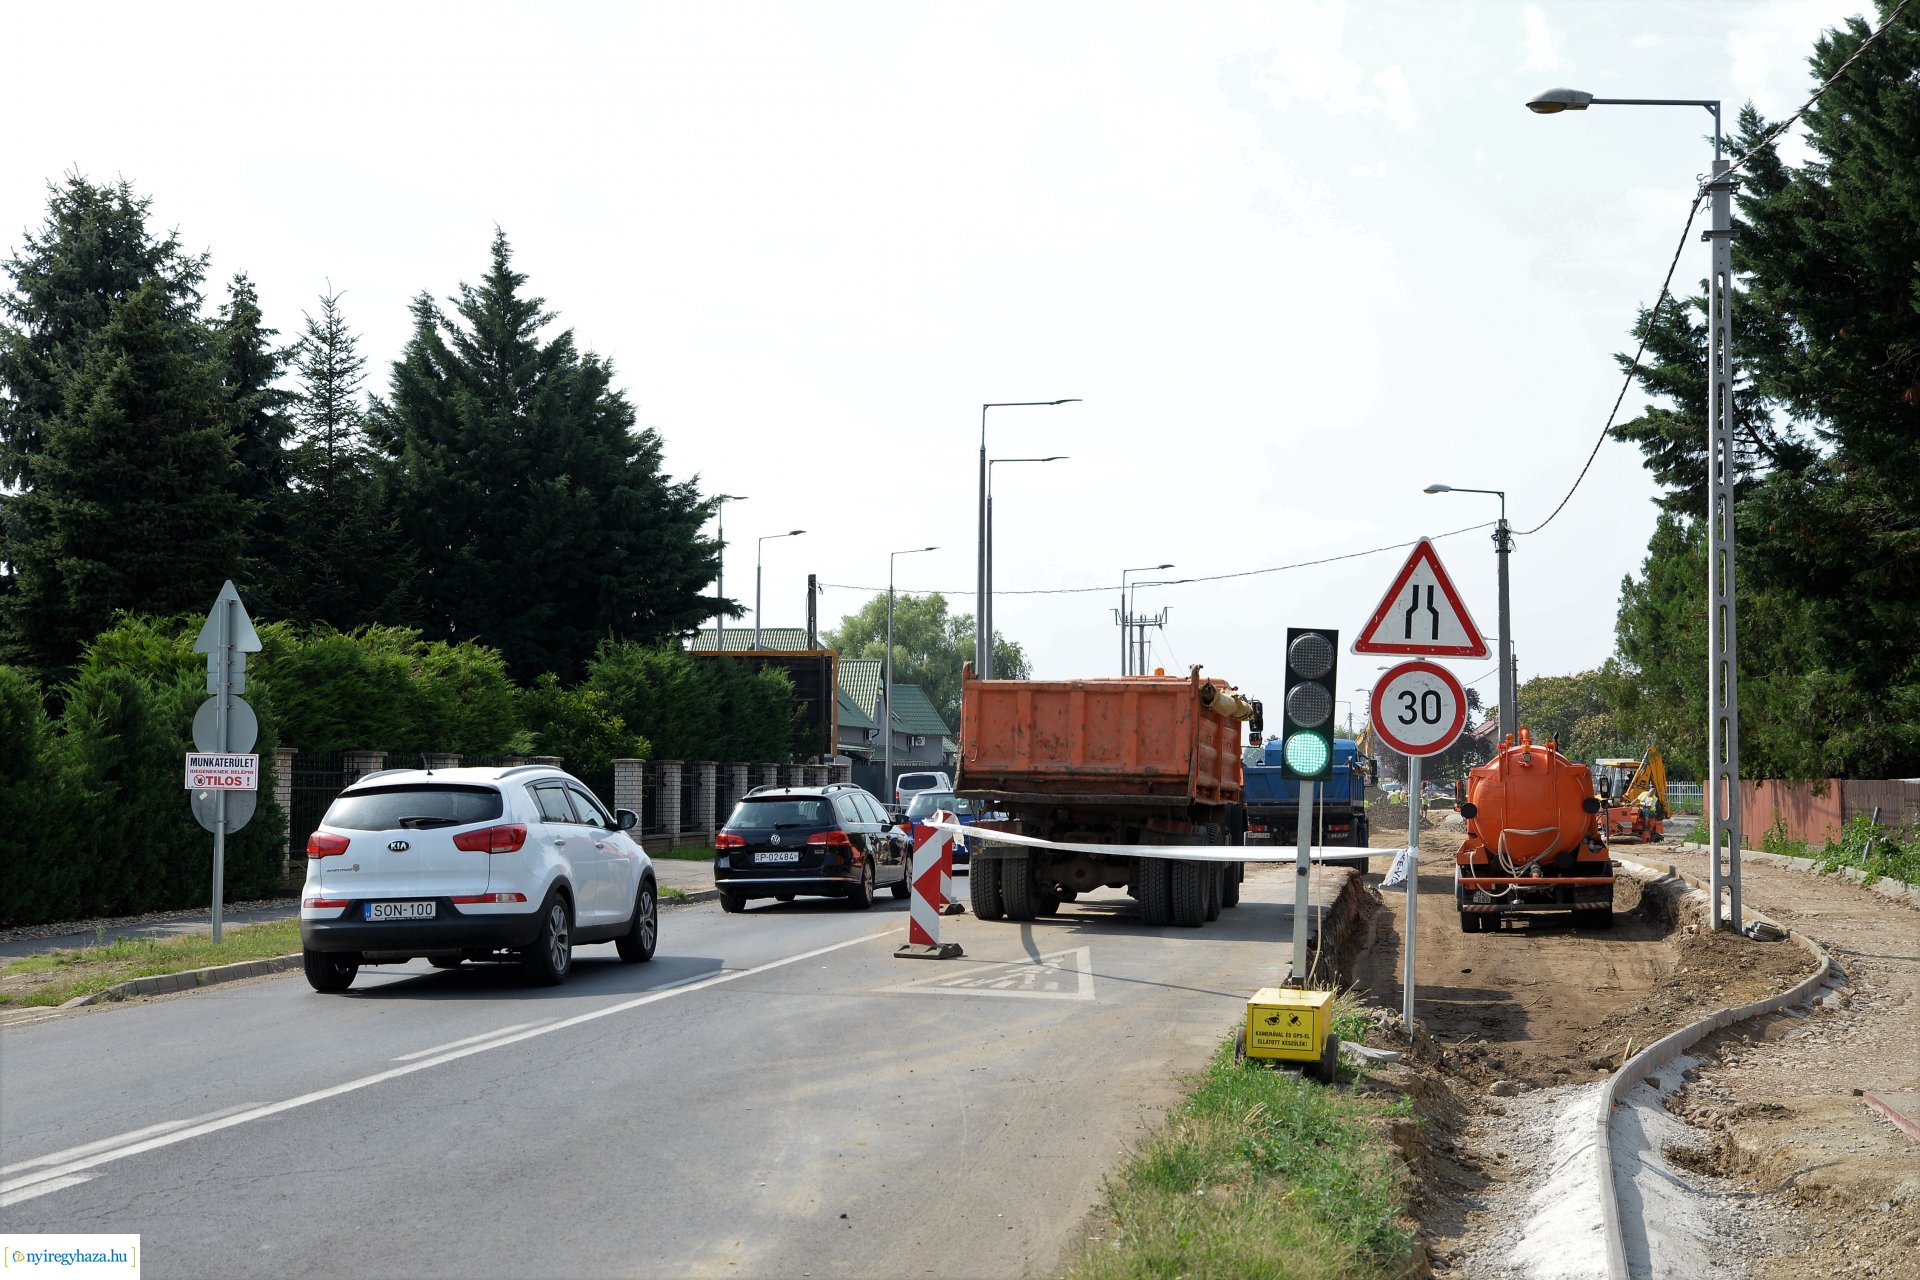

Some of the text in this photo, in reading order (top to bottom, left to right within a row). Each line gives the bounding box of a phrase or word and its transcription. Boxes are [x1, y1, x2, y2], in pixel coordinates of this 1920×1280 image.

[1398, 690, 1441, 725] 30
[190, 757, 254, 767] MUNKATERÜLET
[206, 776, 242, 786] TILOS
[390, 842, 407, 850] KIA
[374, 903, 433, 917] SON-100
